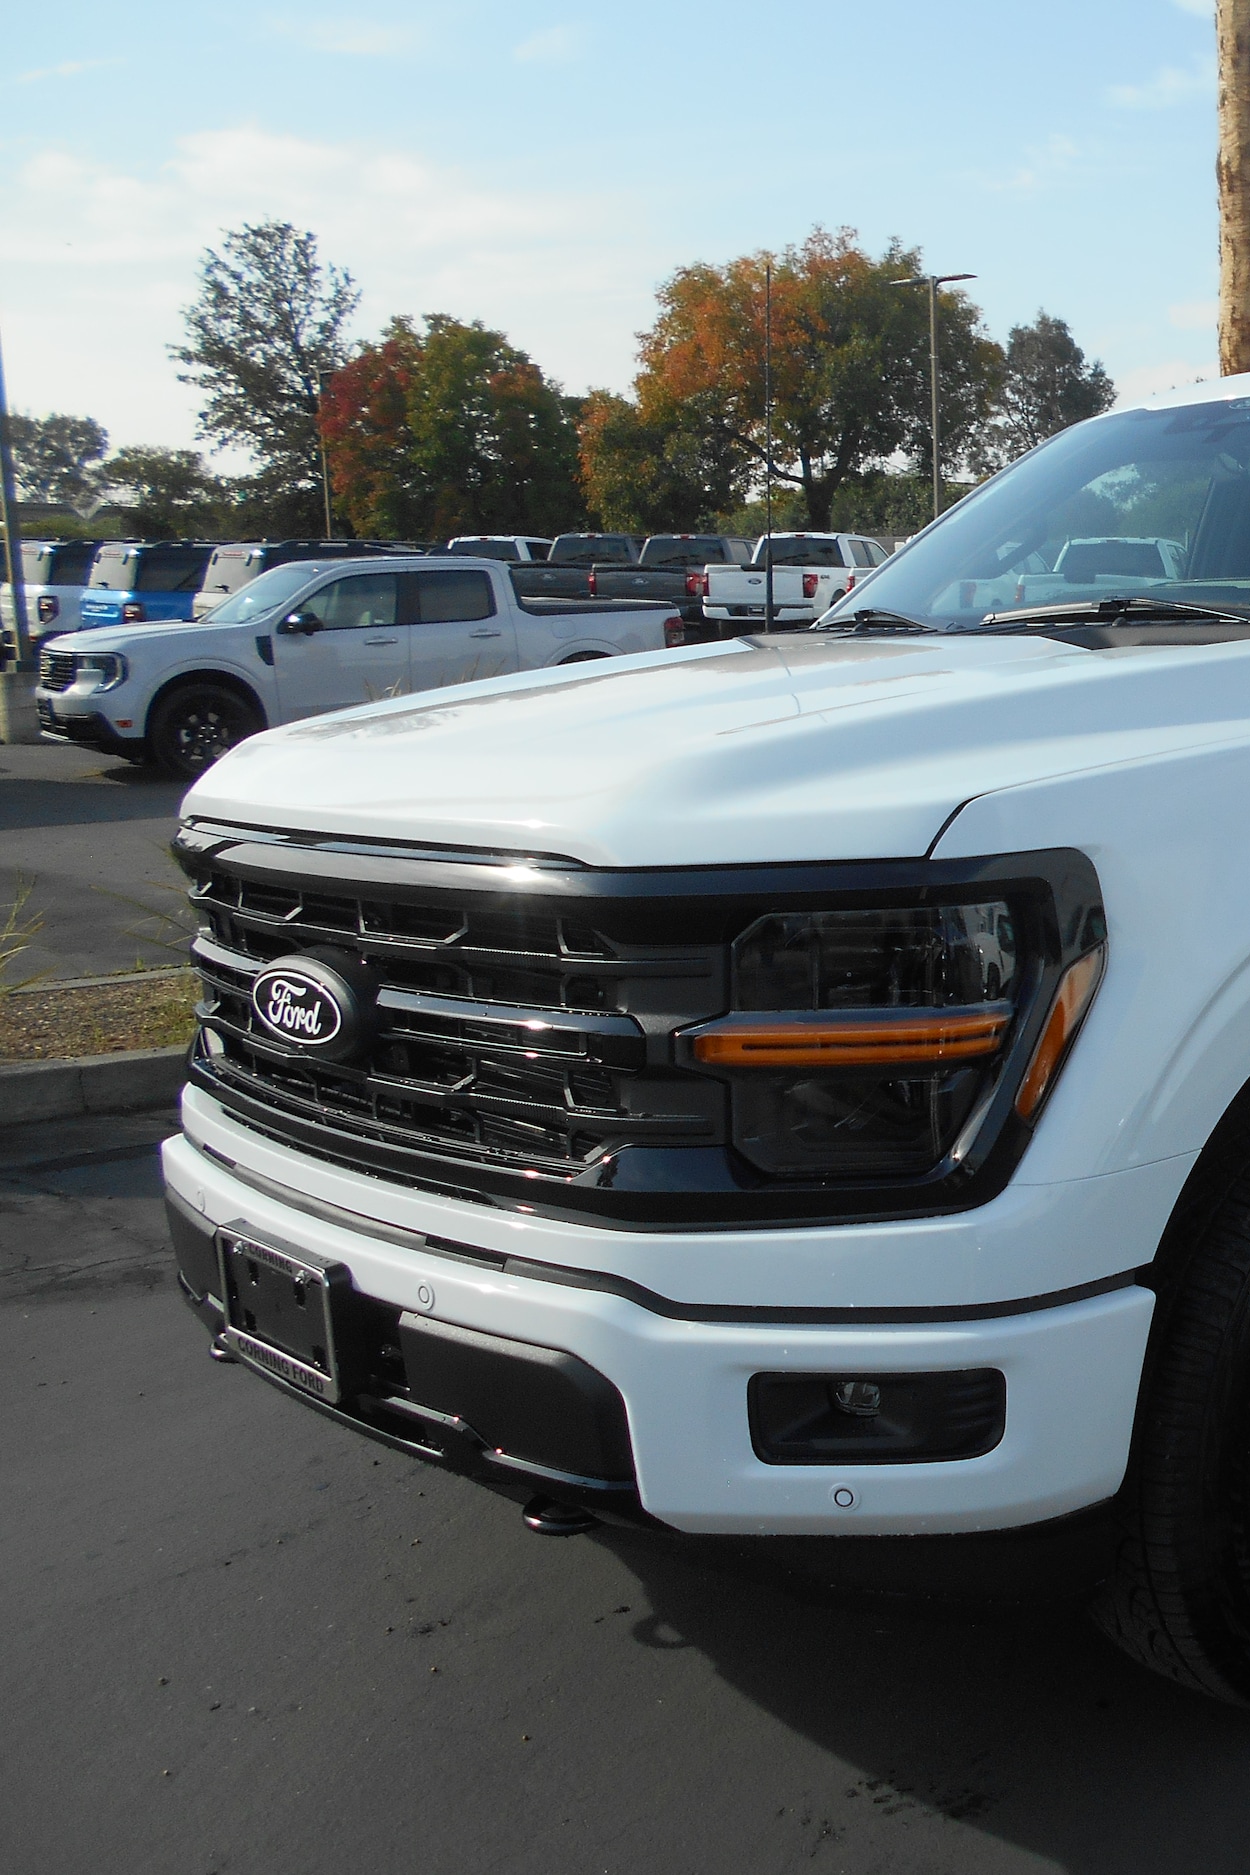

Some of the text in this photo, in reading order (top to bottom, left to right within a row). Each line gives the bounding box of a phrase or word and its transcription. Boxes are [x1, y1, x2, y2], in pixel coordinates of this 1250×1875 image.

[267, 978, 322, 1036] Ford
[237, 1336, 325, 1395] CORNING FORD
